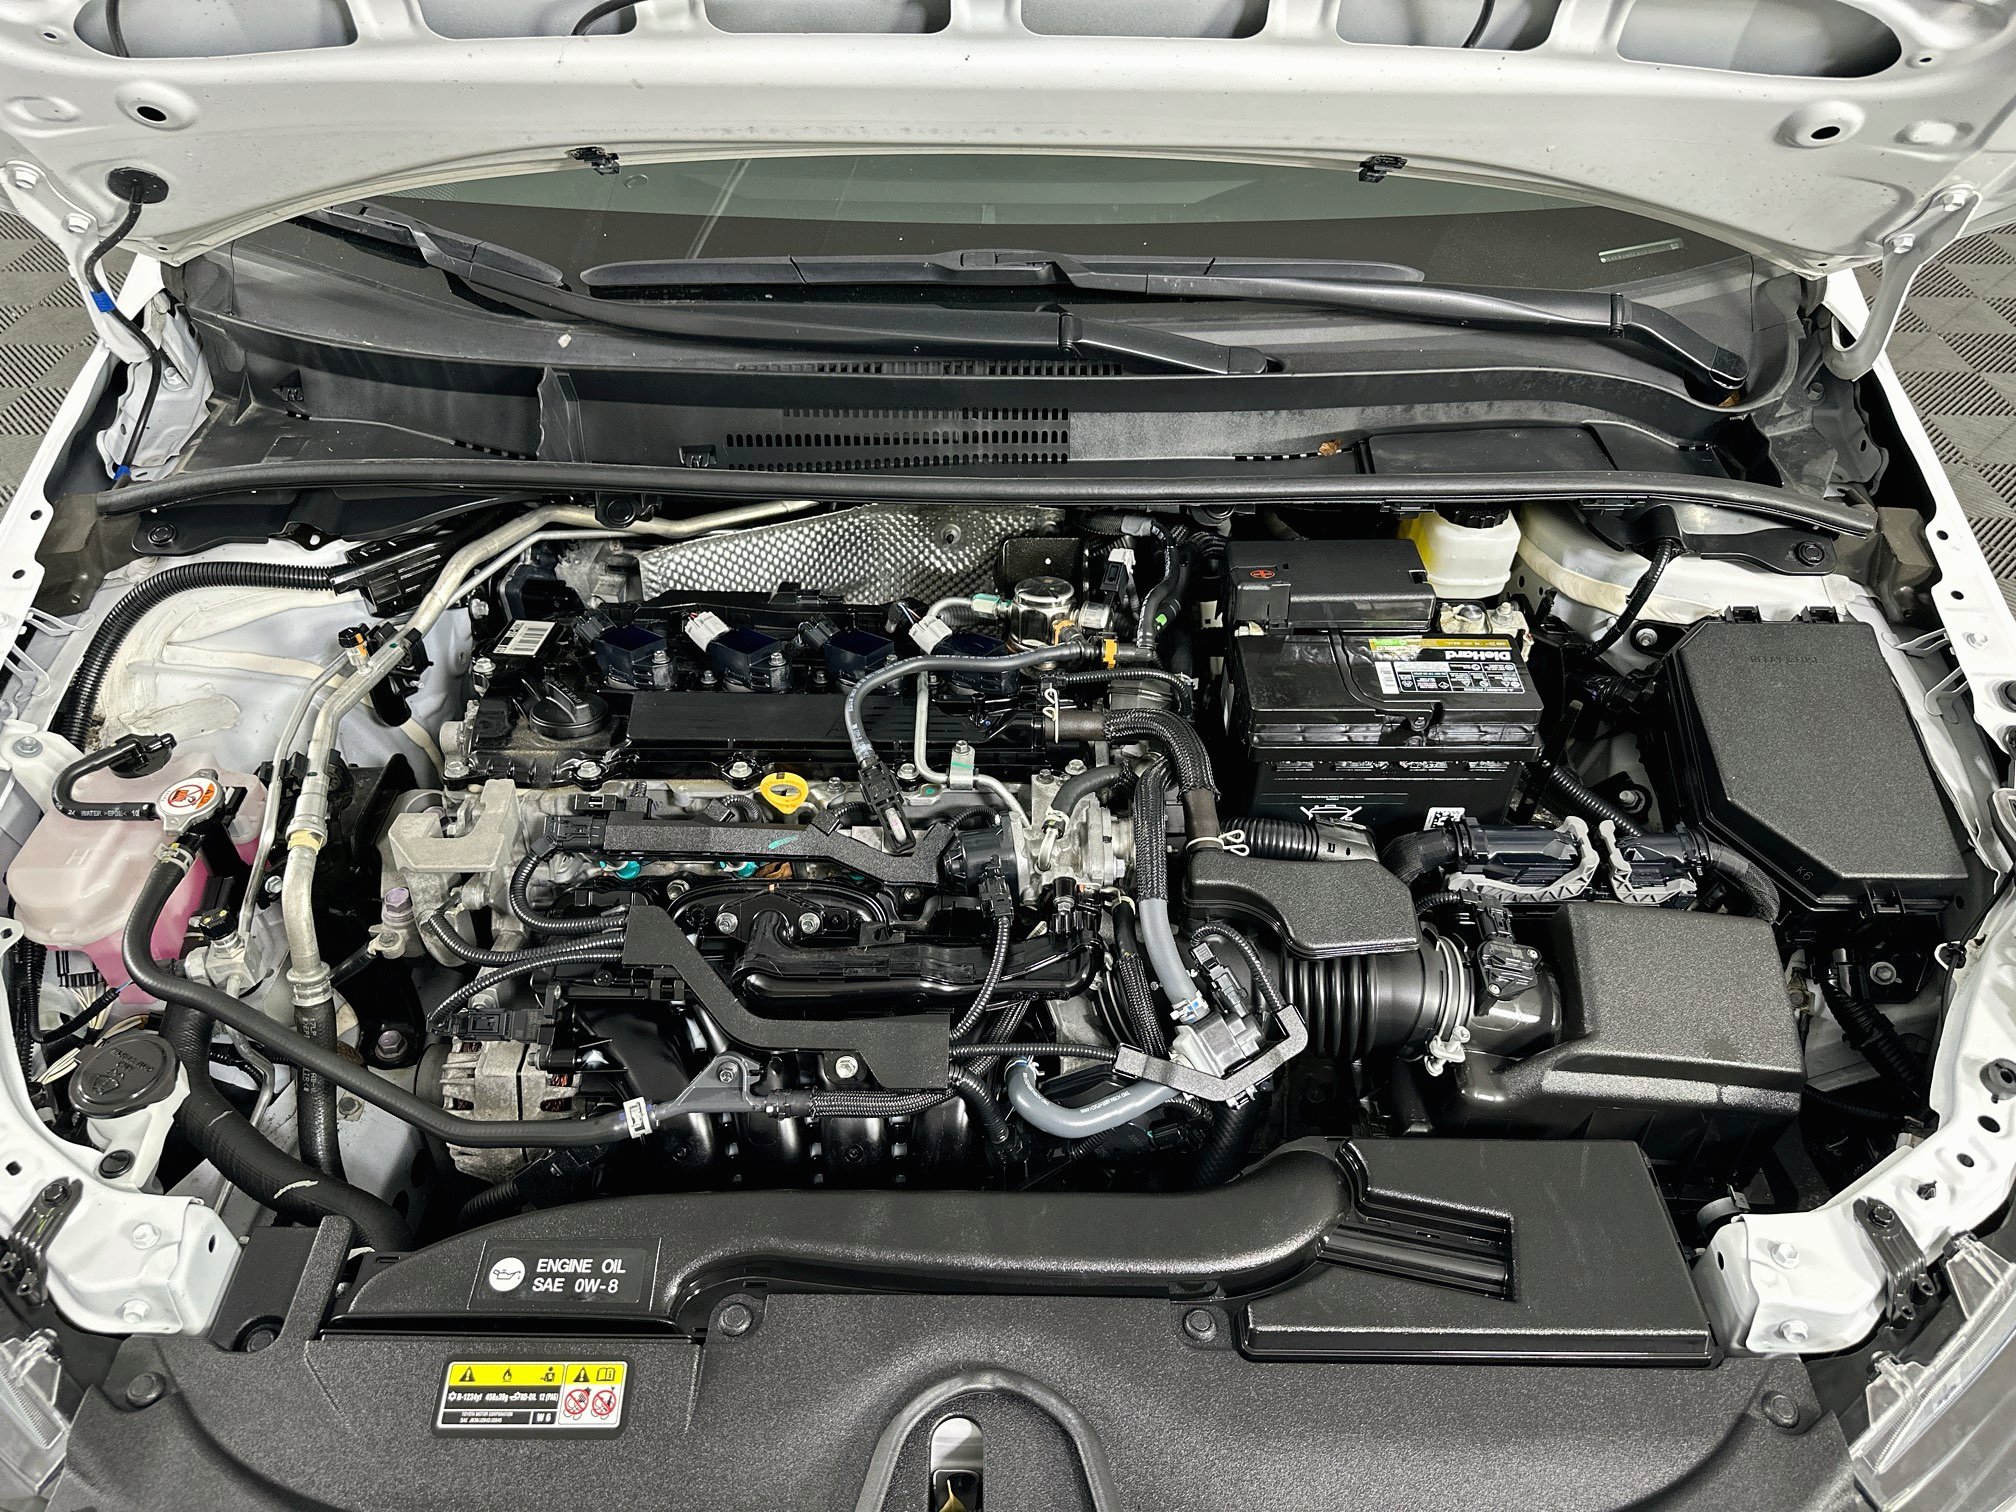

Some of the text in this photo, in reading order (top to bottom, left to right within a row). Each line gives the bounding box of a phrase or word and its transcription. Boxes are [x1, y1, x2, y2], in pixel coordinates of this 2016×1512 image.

[1445, 651, 1511, 660] DieHard
[536, 1259, 626, 1274] ENGINE OIL
[532, 1278, 619, 1293] SAE 0W-8
